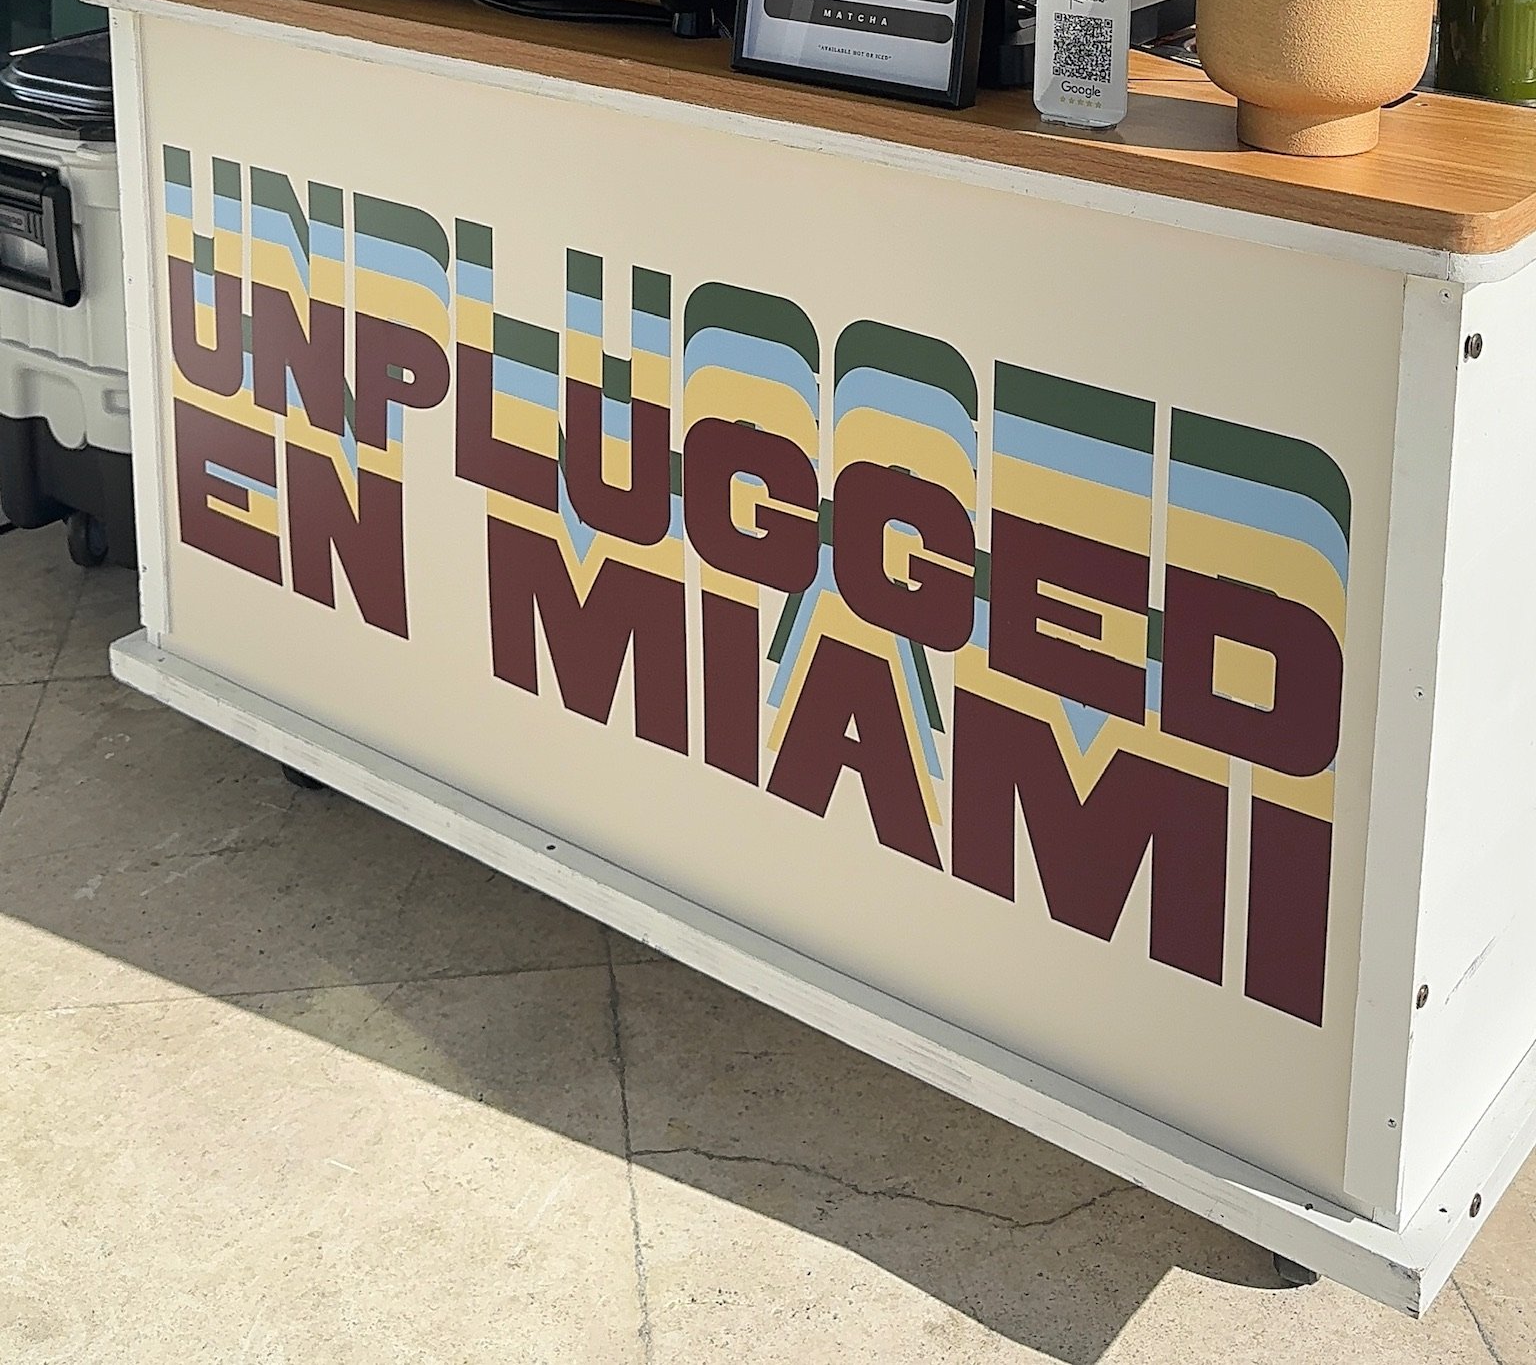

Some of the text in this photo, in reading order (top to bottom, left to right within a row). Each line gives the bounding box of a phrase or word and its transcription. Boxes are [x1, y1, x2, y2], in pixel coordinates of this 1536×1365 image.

[823, 9, 889, 26] MATCHA
[1061, 81, 1101, 99] Google
[165, 235, 1345, 778] UNPLUGGED
[173, 396, 1335, 1027] EN MIAMI
